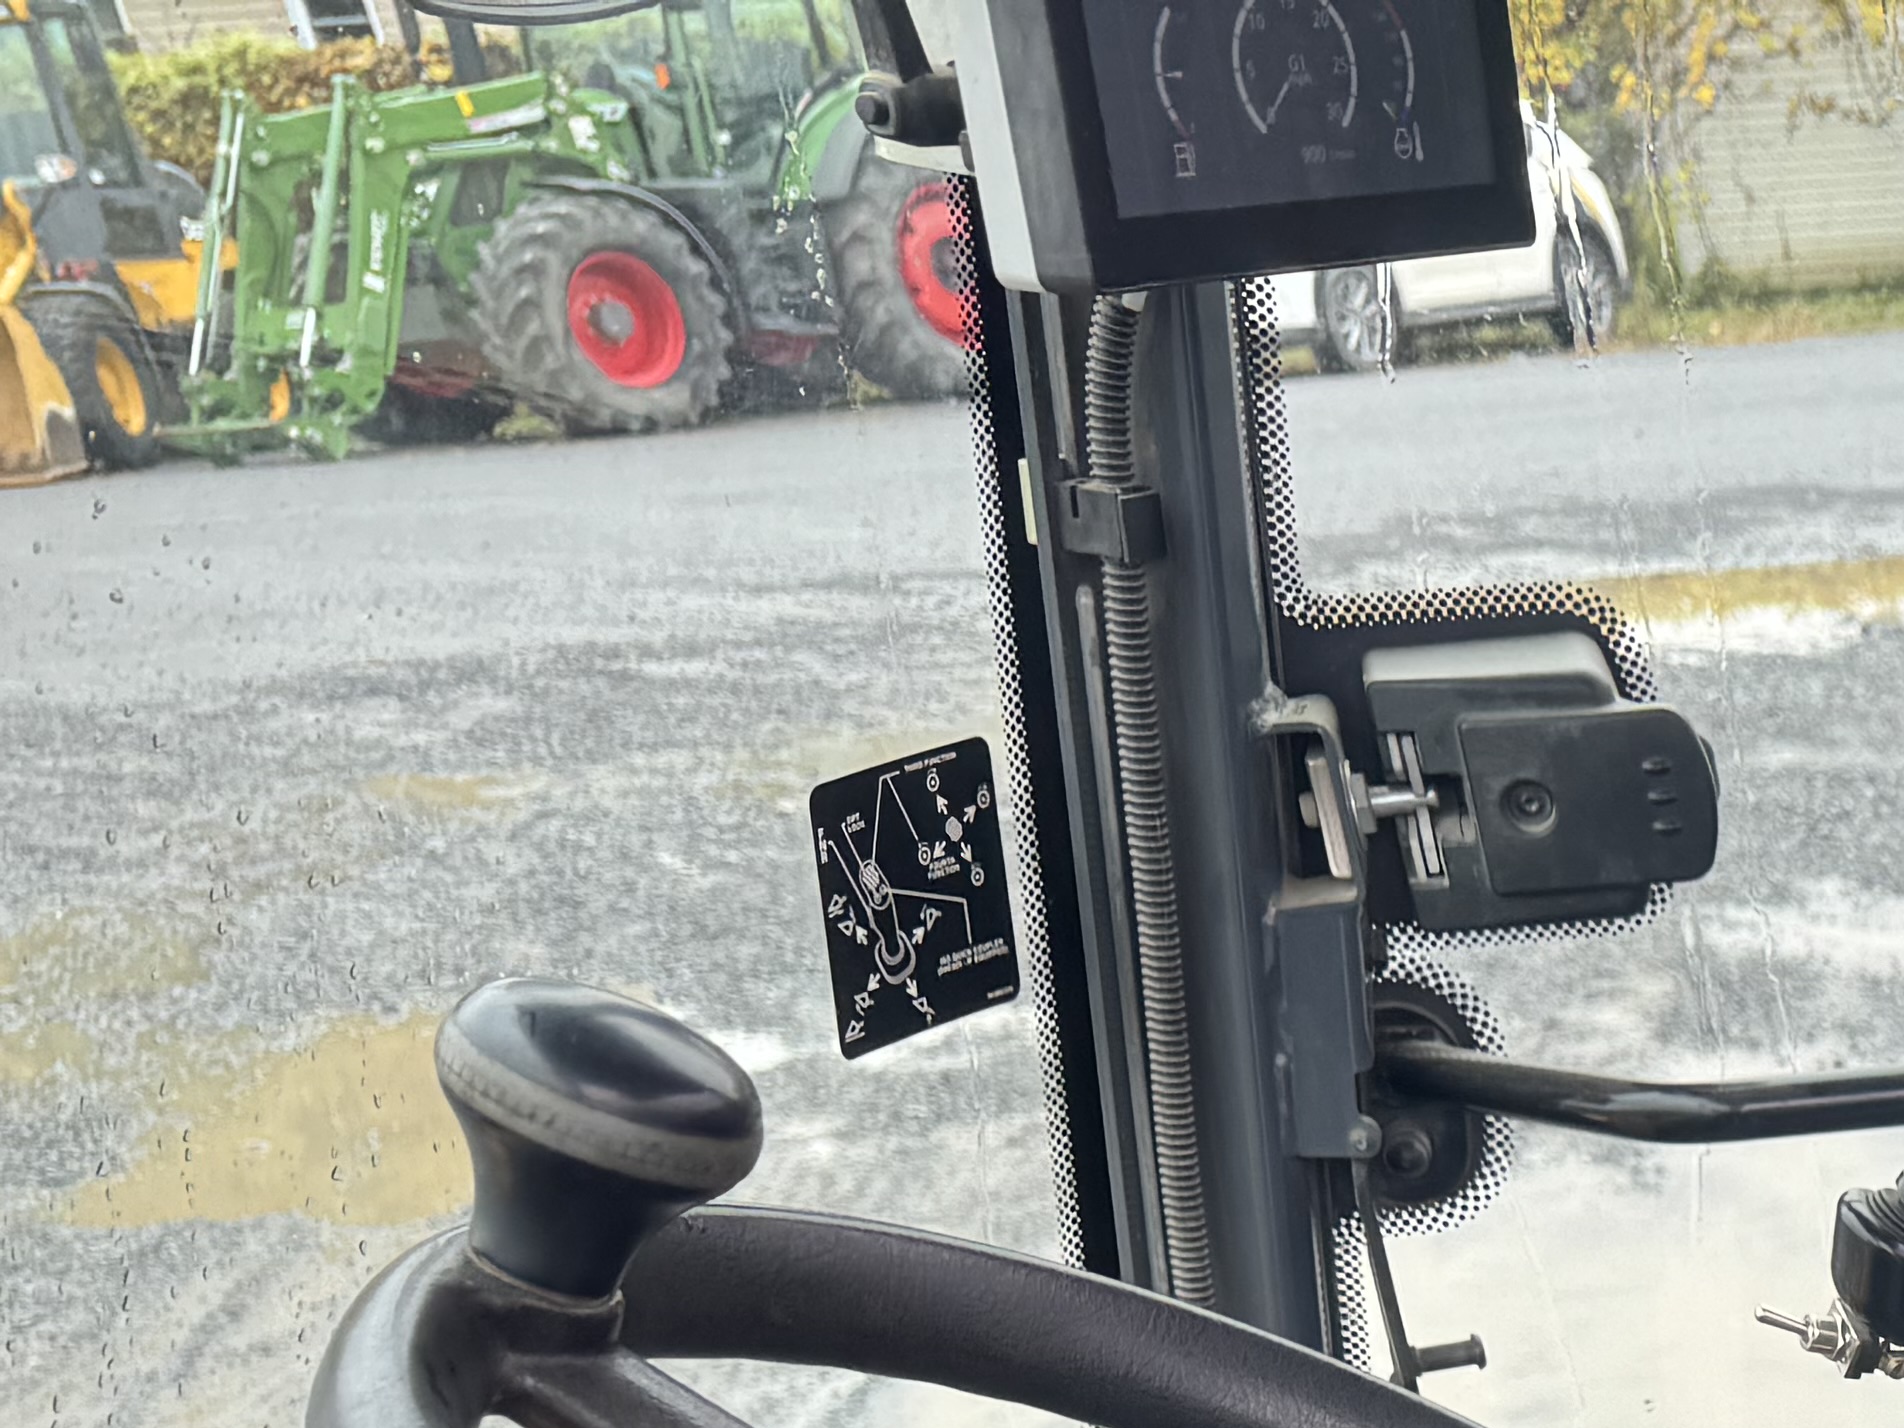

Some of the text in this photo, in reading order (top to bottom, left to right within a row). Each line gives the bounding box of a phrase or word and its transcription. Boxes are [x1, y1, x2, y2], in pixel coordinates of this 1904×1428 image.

[1248, 13, 1265, 30] 10
[1312, 10, 1330, 29] 20
[1332, 56, 1349, 75] 25
